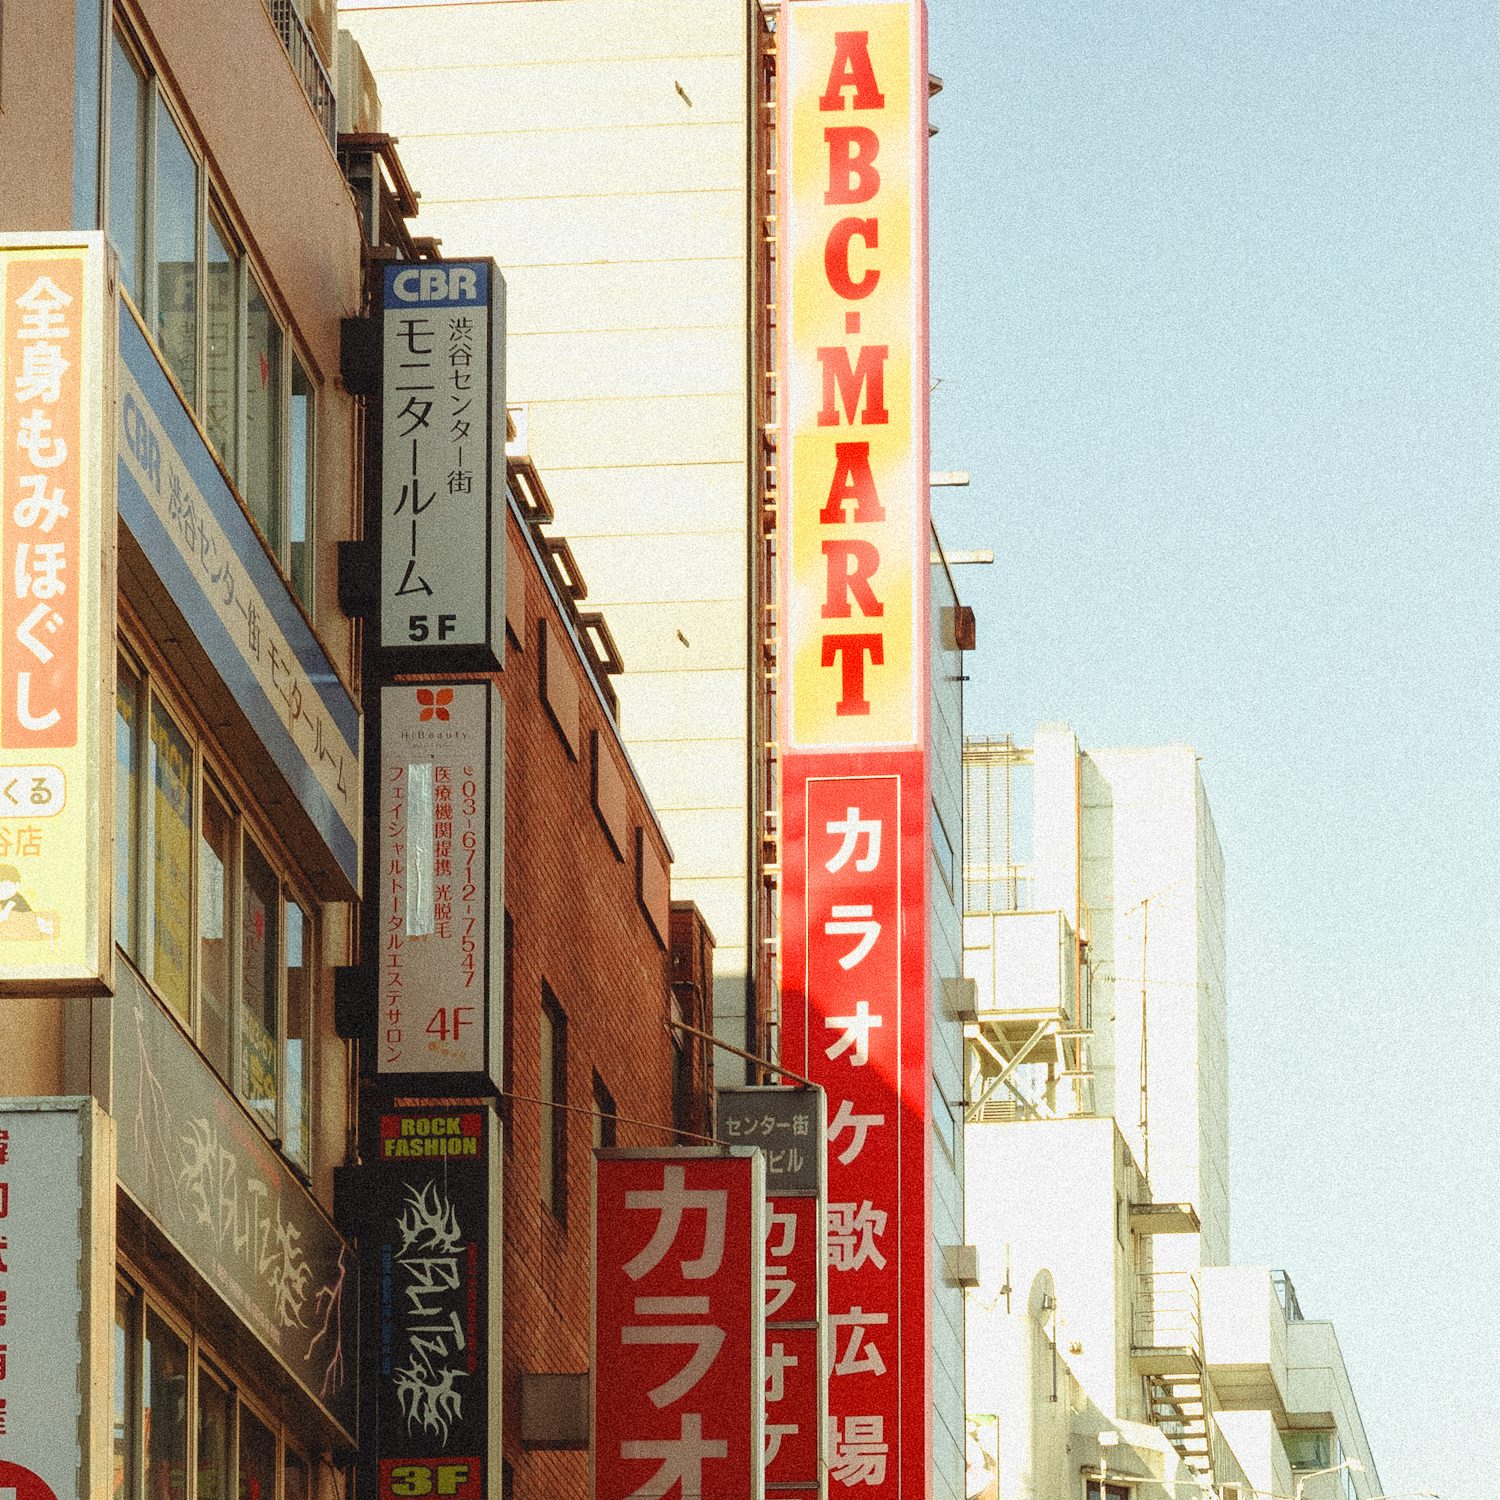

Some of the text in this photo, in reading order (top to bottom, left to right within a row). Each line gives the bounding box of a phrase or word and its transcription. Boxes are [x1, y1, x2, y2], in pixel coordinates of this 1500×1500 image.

[393, 269, 477, 301] CBR
[446, 318, 473, 494] 渋谷センター街
[817, 31, 888, 716] ABC-MART
[14, 275, 73, 731] 全身もみほぐし
[394, 319, 436, 597] モニタールーム
[123, 392, 348, 800] CBR 渋谷センター街 モニタールーム
[434, 767, 452, 939] 医療機関提携 光脱毛
[425, 1006, 475, 1041] 4F
[384, 1137, 478, 1158] FASHION
[400, 1116, 462, 1136] ROCK
[726, 1112, 810, 1140] センター街
[391, 1463, 468, 1497] 3F
